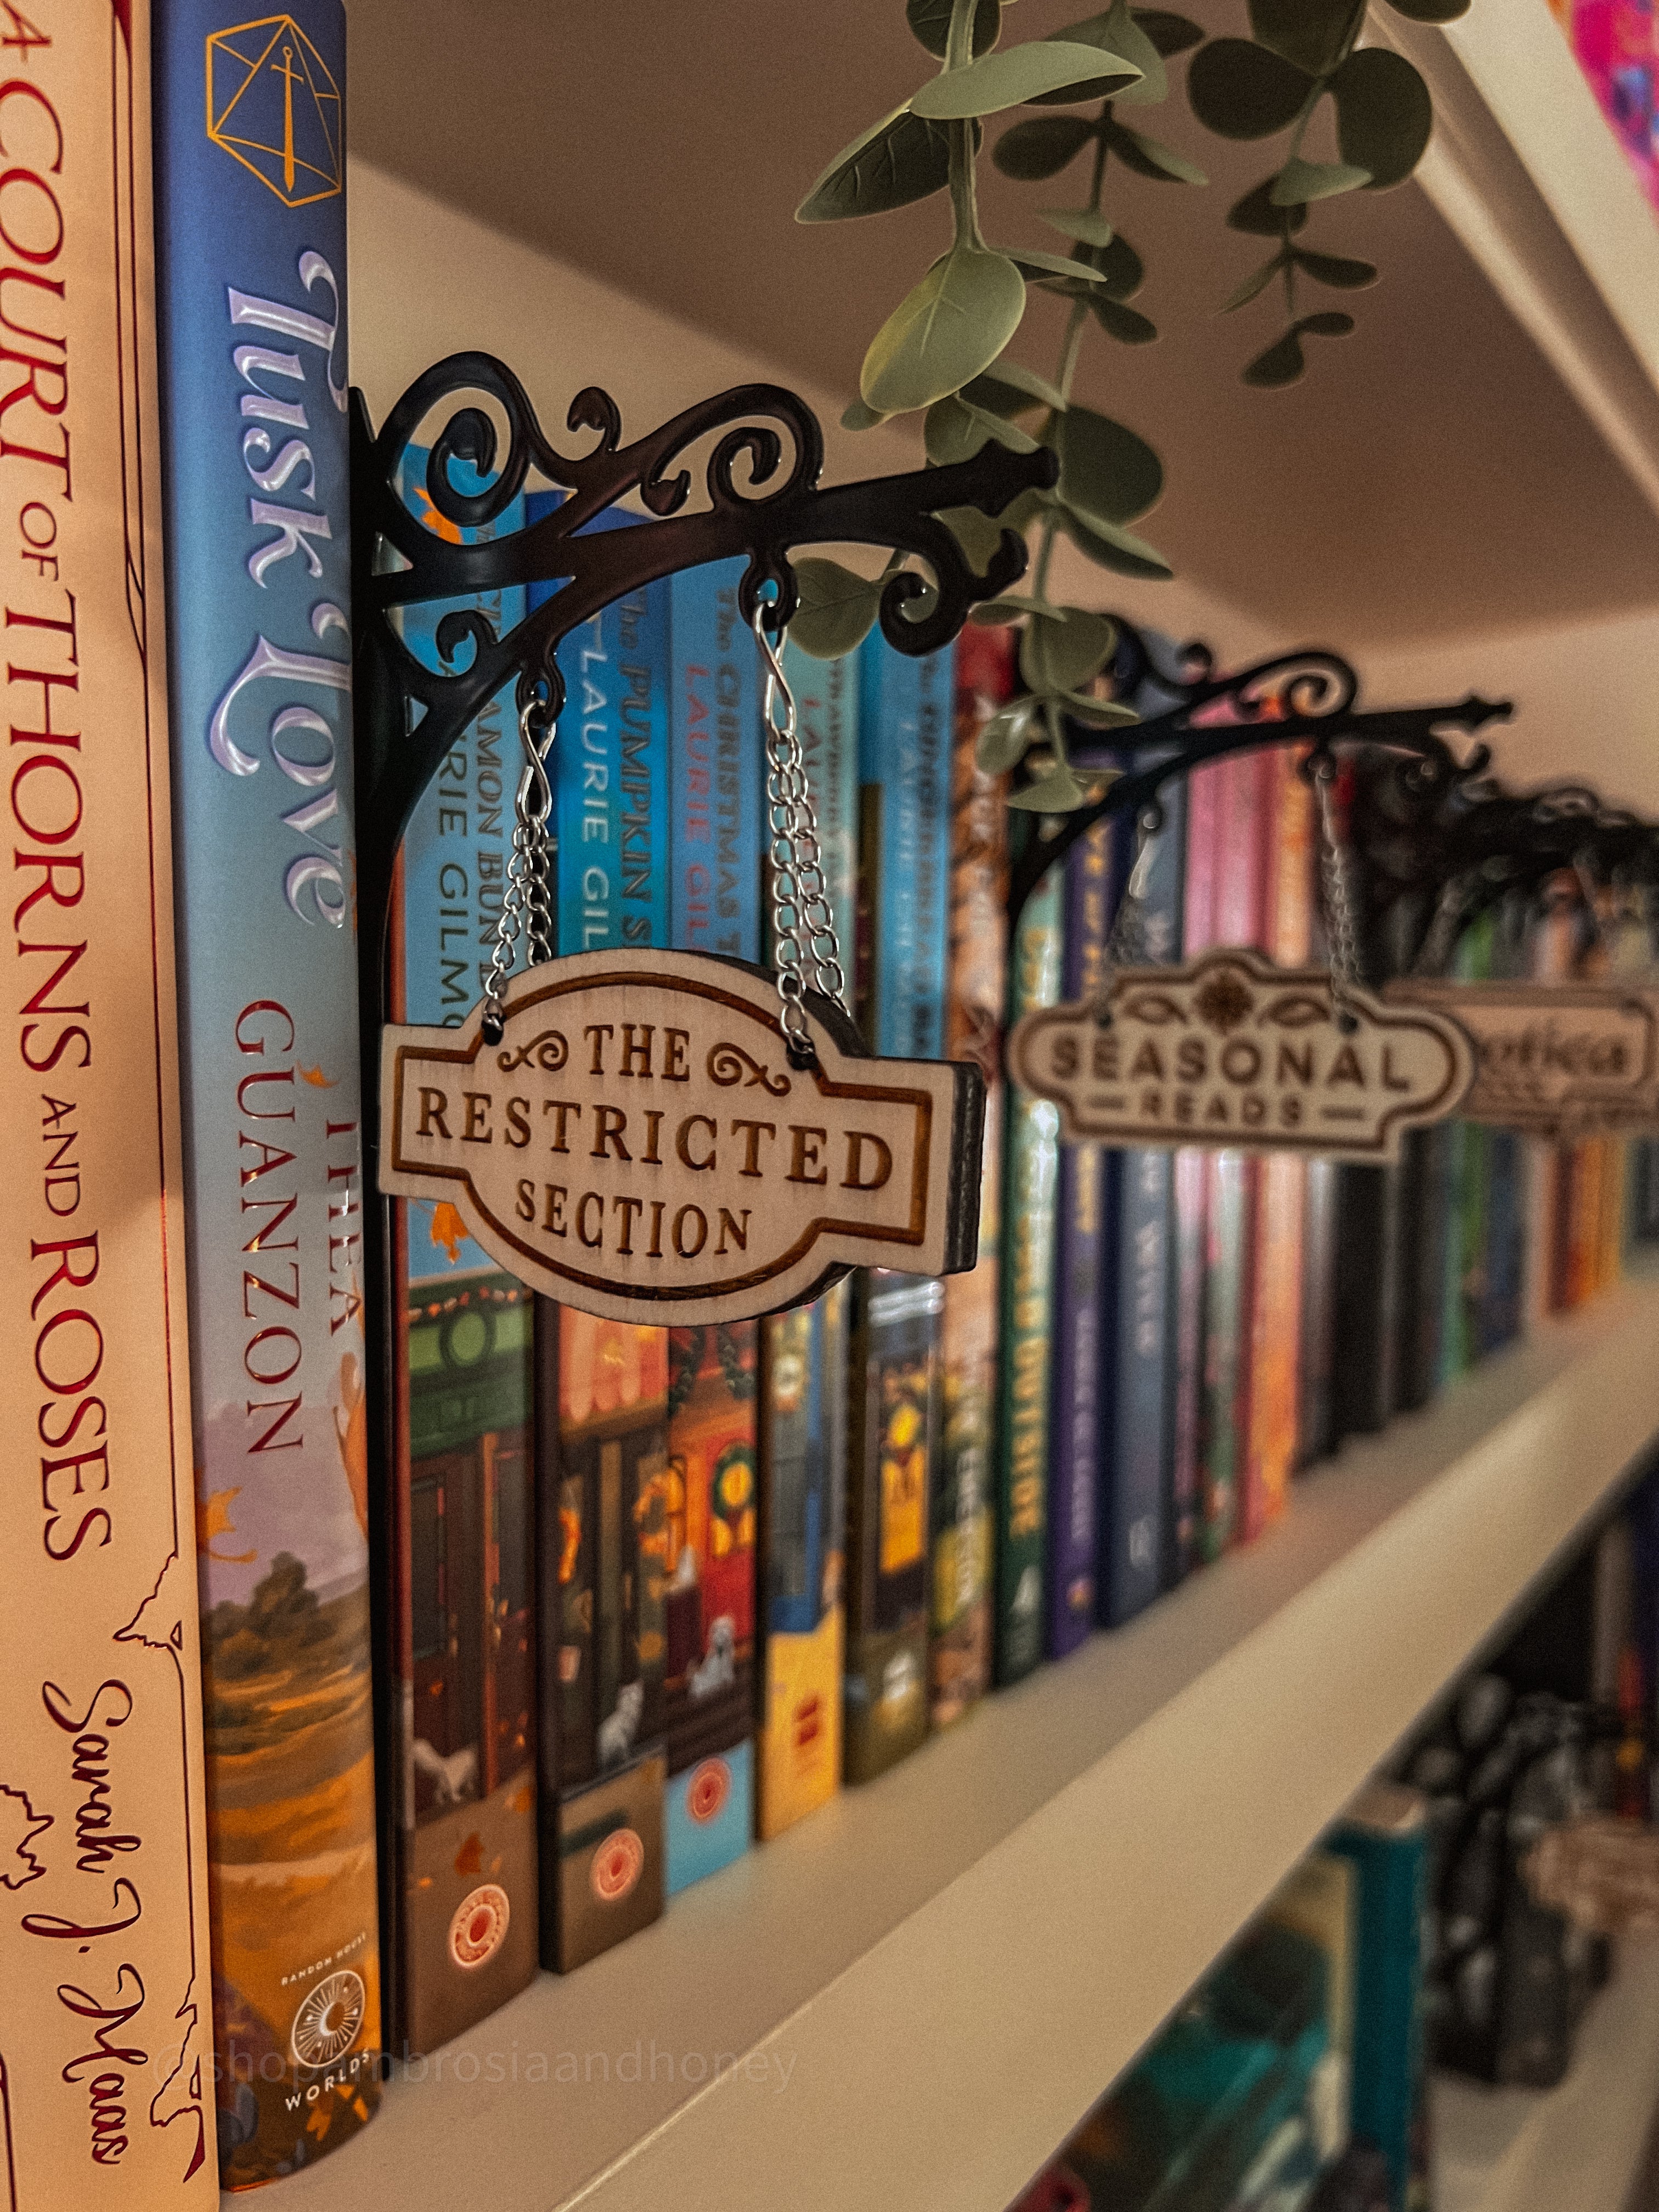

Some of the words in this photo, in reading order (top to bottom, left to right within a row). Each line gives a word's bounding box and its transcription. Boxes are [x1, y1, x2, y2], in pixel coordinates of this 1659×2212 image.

[0, 78, 72, 501] COURT
[228, 250, 348, 589] Tusk
[19, 501, 59, 582] OF
[5, 589, 91, 1073] THORNS
[210, 602, 353, 928] Love
[582, 650, 608, 843] LAURIE
[618, 663, 653, 903] PUMPKIN
[685, 663, 712, 845] LAURIE
[716, 663, 742, 919] CHRISTMAS
[685, 861, 712, 951] GIL
[415, 1086, 893, 1191] RESTRICTED
[584, 1023, 691, 1082] THE
[1049, 1031, 1412, 1093] SEASONAL
[1140, 1091, 1302, 1128] READS
[41, 1094, 82, 1217] AND
[234, 999, 303, 1454] GUANZON
[326, 1119, 363, 1338] THEA
[515, 1178, 752, 1259] SECTION
[31, 1229, 112, 1561] ROSES
[42, 1679, 142, 1874] Sarah
[21, 1877, 142, 1954] J.
[281, 1956, 332, 1986] RANDOM
[57, 1963, 148, 2164] Maas
[285, 2047, 370, 2112] WORLDS
